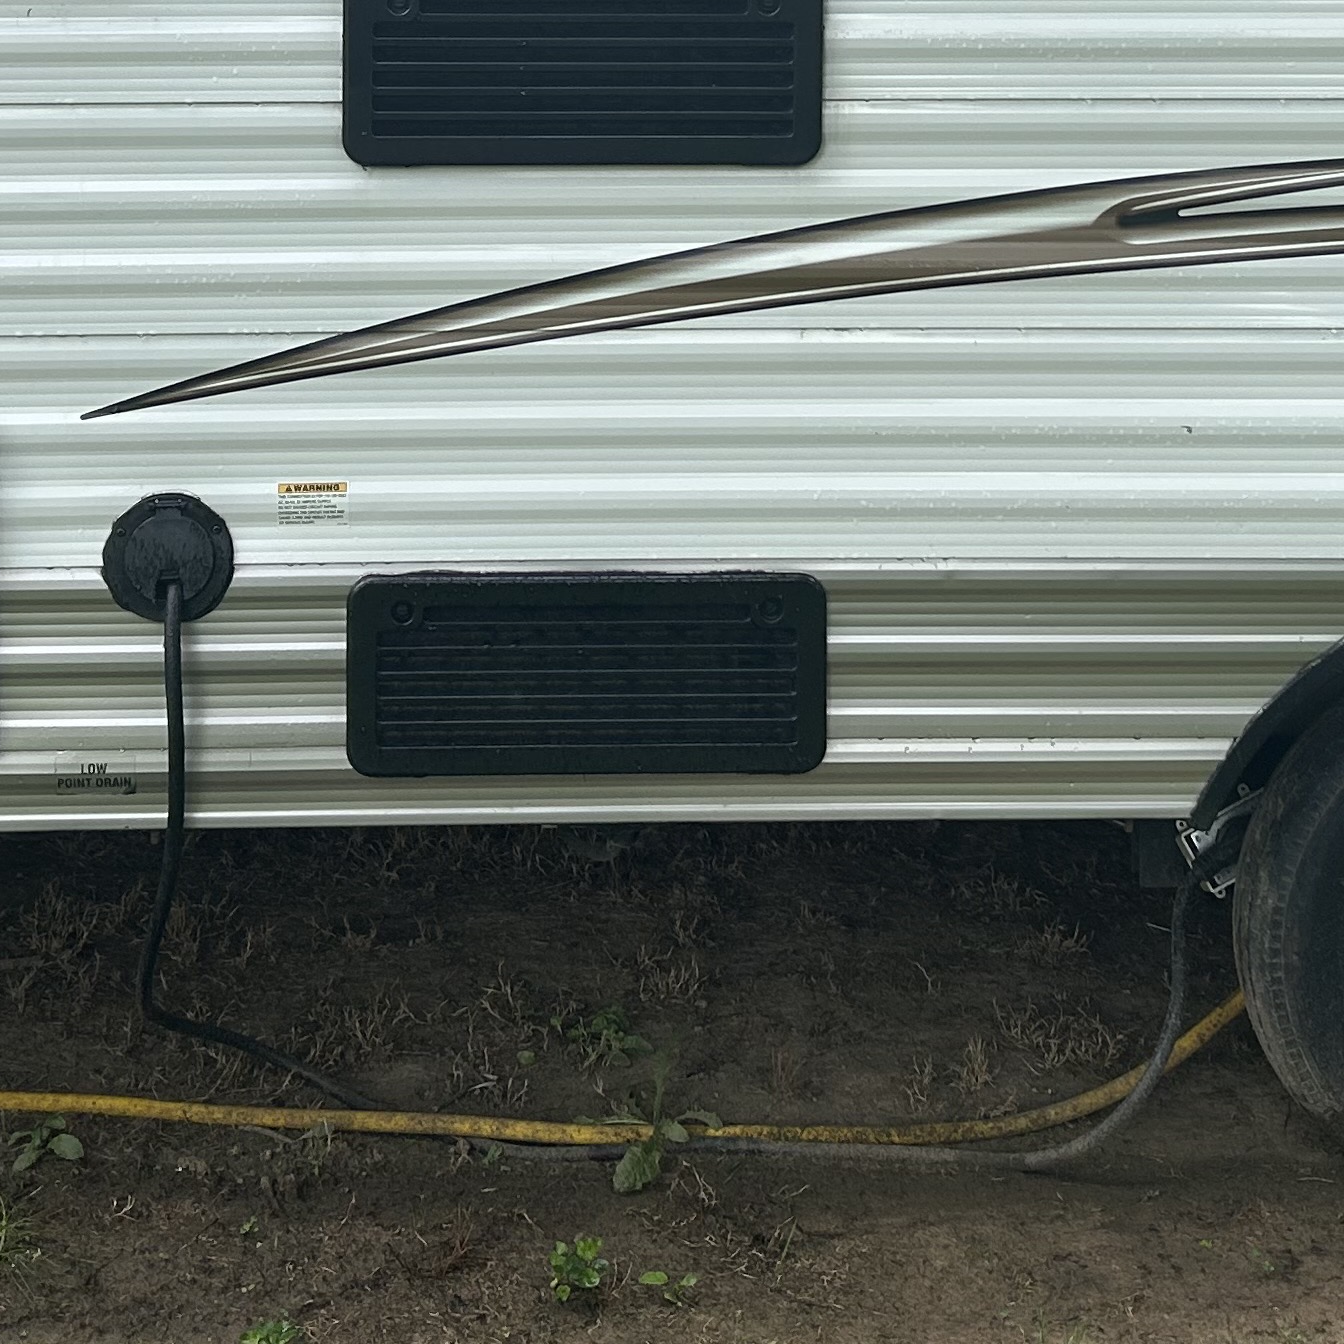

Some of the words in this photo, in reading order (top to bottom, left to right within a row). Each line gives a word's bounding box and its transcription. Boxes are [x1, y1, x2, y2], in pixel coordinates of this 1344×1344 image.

[293, 483, 340, 492] WARNING
[80, 762, 108, 775] LOW
[57, 777, 92, 788] POINT
[95, 776, 131, 787] DRAIN
